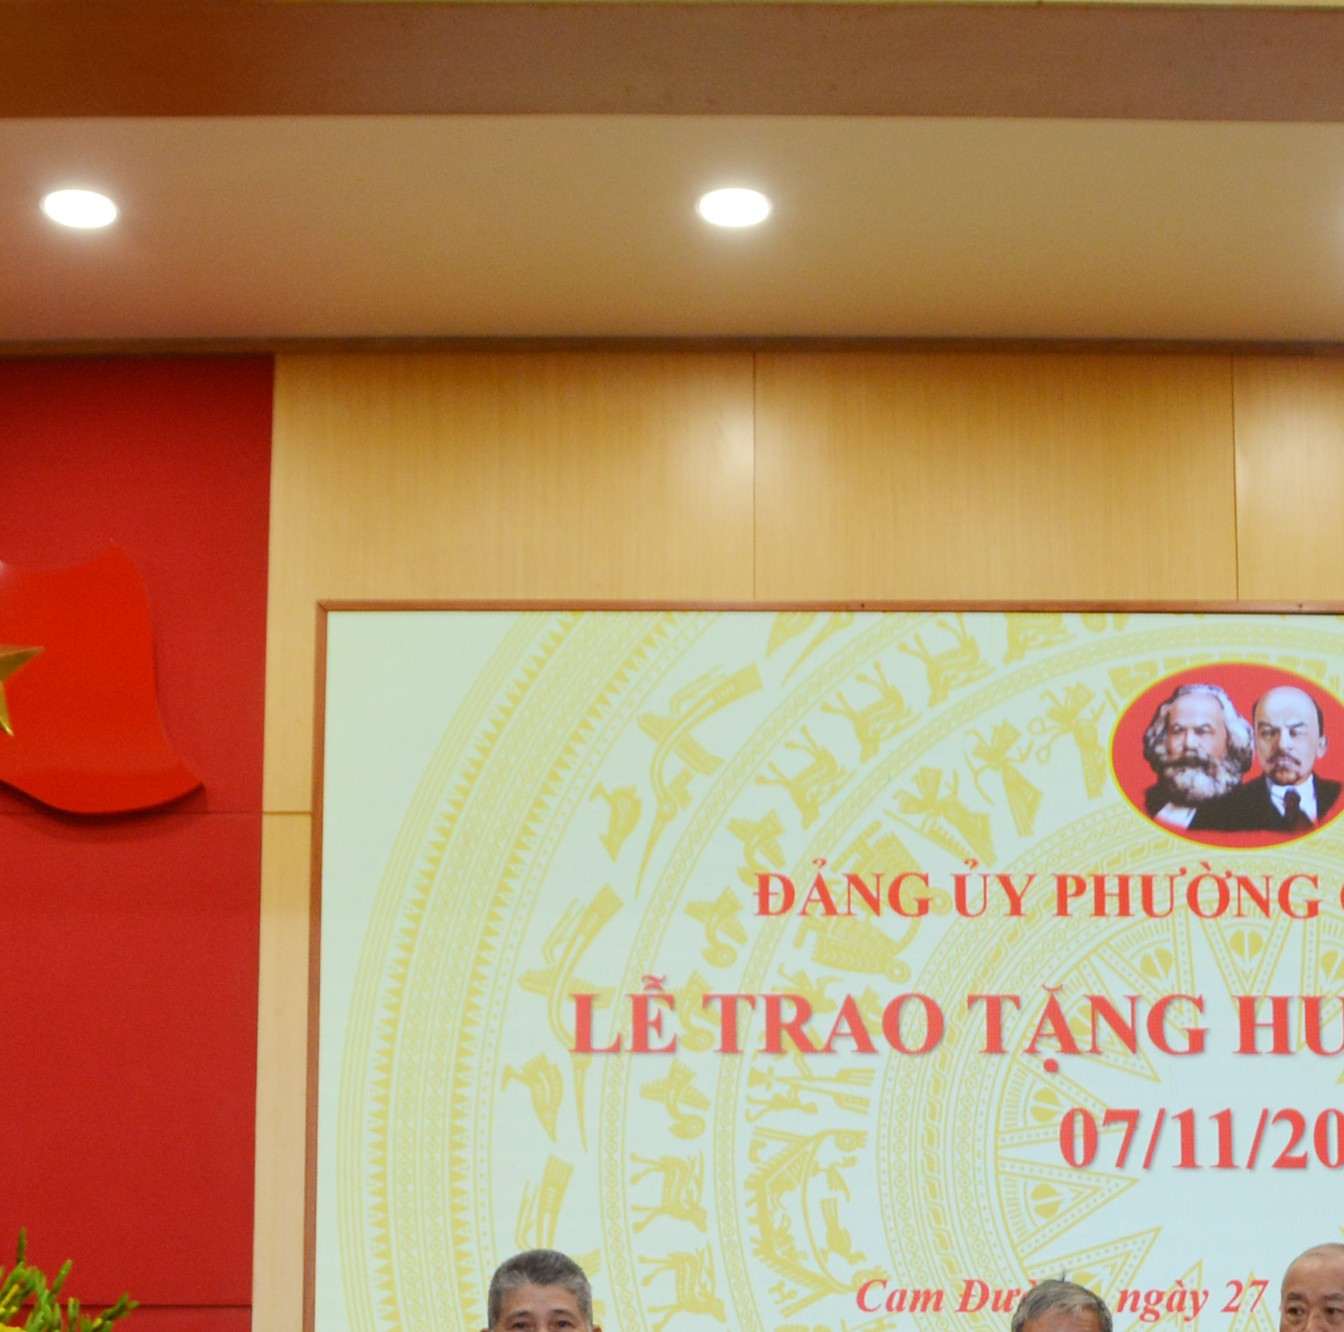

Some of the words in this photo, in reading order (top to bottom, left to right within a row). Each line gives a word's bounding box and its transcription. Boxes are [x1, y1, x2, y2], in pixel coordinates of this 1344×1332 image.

[753, 858, 934, 918] ĐẢNG
[952, 858, 1037, 918] ỦY
[1054, 868, 1321, 921] PHƯỜNG
[570, 977, 678, 1056] LỄ
[703, 994, 945, 1056] TRAO
[968, 988, 1206, 1075] TẶNG
[856, 1279, 946, 1314] Cam
[1116, 1280, 1210, 1323] ngày
[1223, 1279, 1270, 1314] 27
